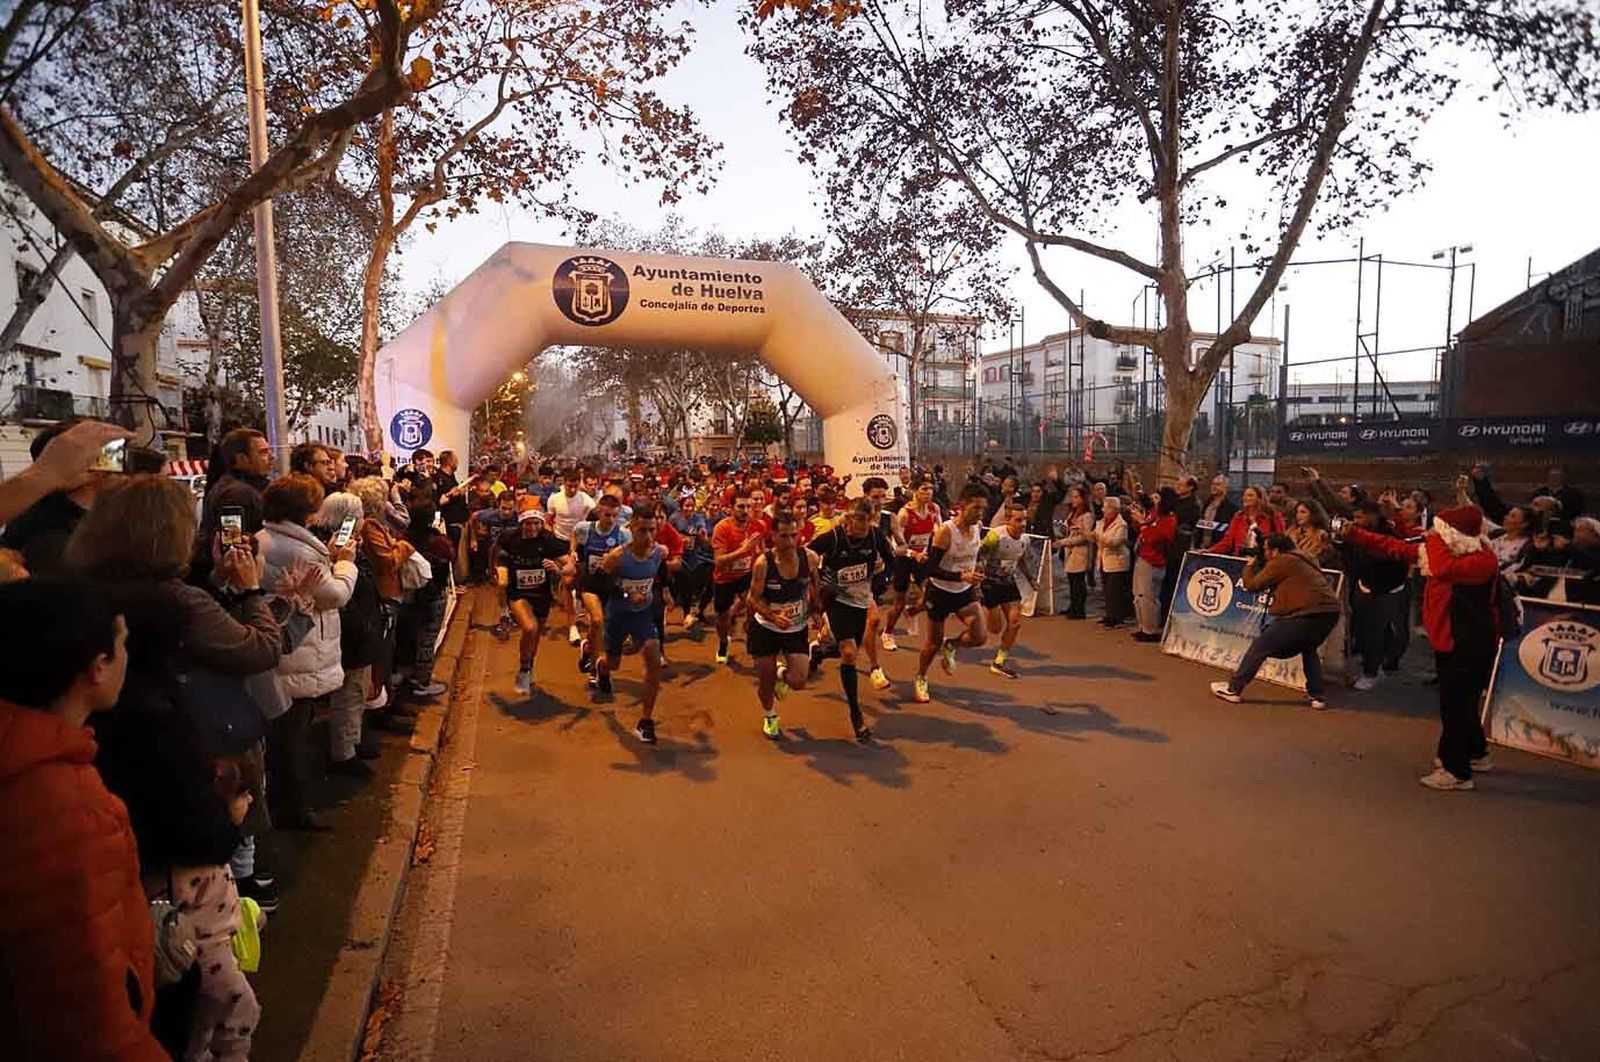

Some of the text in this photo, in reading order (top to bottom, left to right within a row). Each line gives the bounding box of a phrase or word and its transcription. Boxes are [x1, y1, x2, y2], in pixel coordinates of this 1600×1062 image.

[632, 265, 763, 285] Ayuntamiento
[671, 282, 764, 300] de Huelva
[701, 301, 715, 312] de
[717, 302, 766, 315] Deportes
[1306, 431, 1348, 440] HYUNDAI
[1379, 428, 1429, 438] HYUNDAI
[1482, 423, 1546, 435] HYUNDAI
